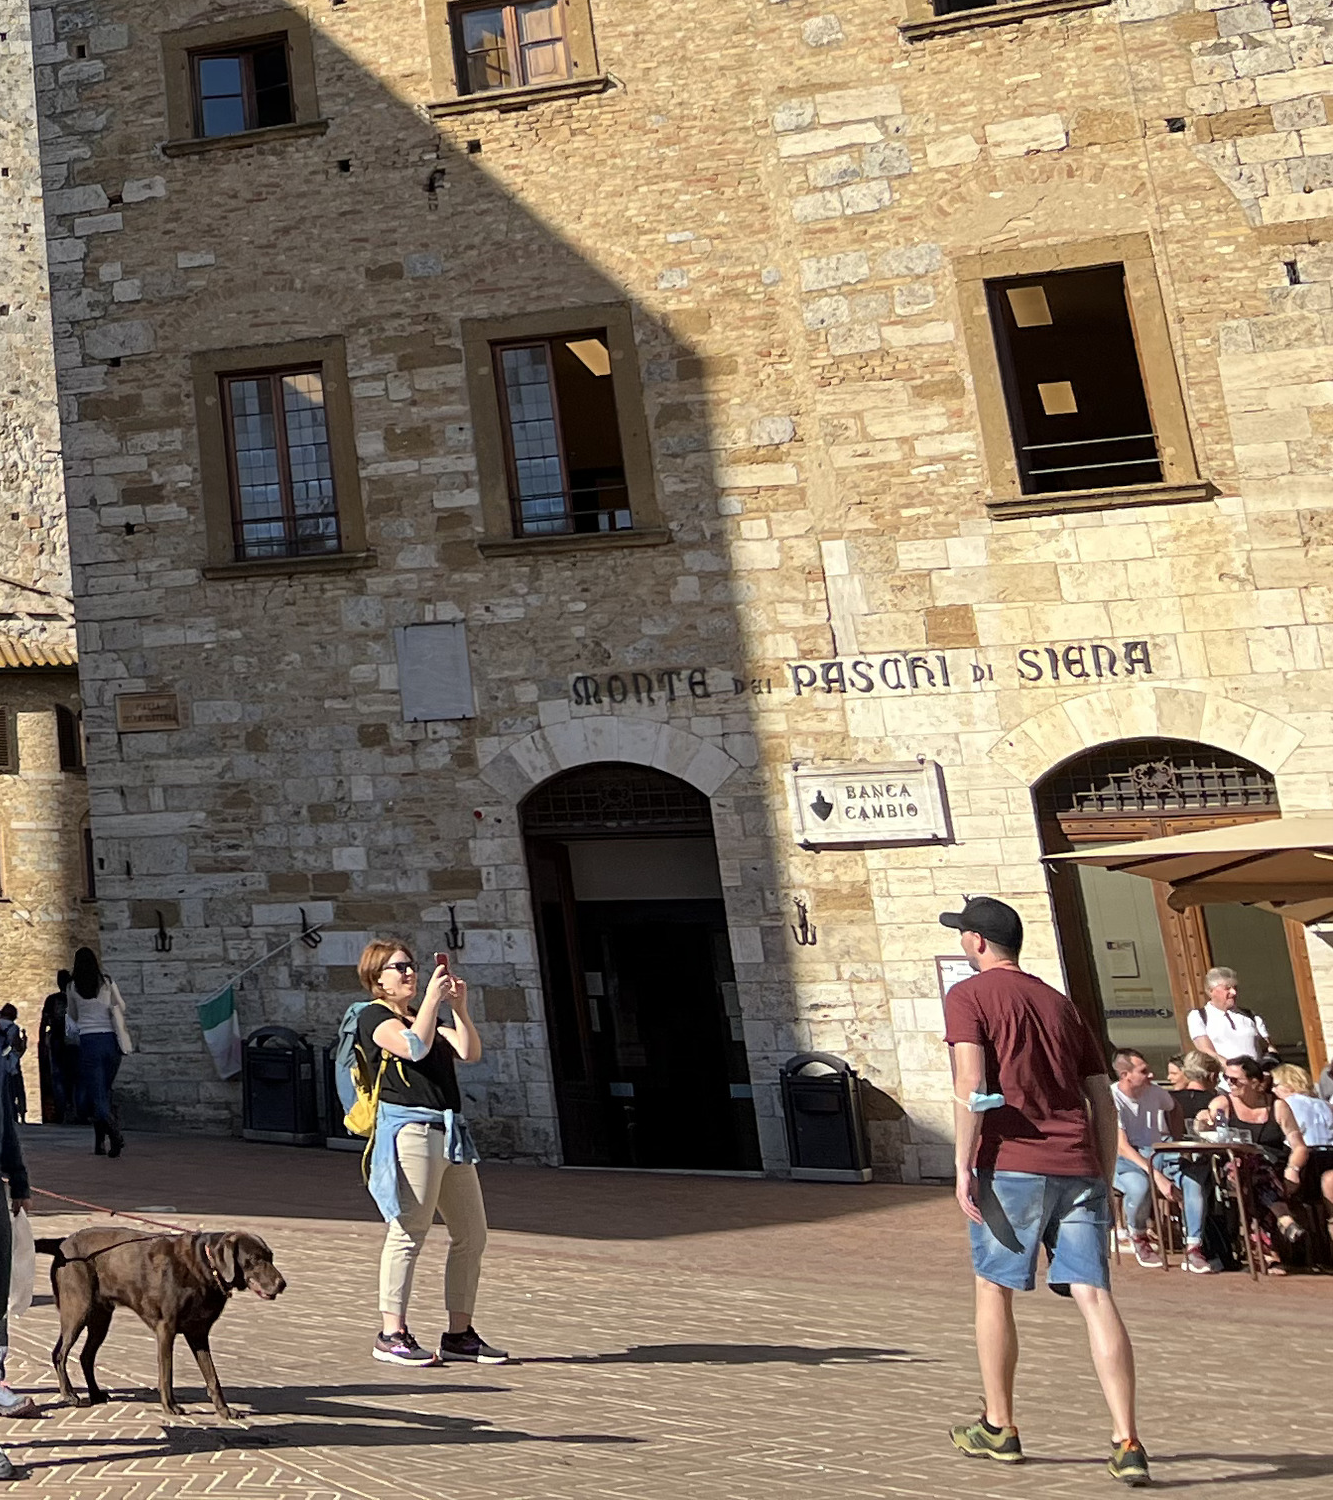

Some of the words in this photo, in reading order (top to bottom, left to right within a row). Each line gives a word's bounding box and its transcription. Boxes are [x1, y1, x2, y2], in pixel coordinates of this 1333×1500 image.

[572, 667, 711, 706] MONTE
[787, 654, 950, 697] PASCHI
[970, 663, 994, 684] DI
[1017, 640, 1153, 682] SIENA
[844, 783, 912, 800] BANCA
[844, 802, 919, 820] CAMBIO
